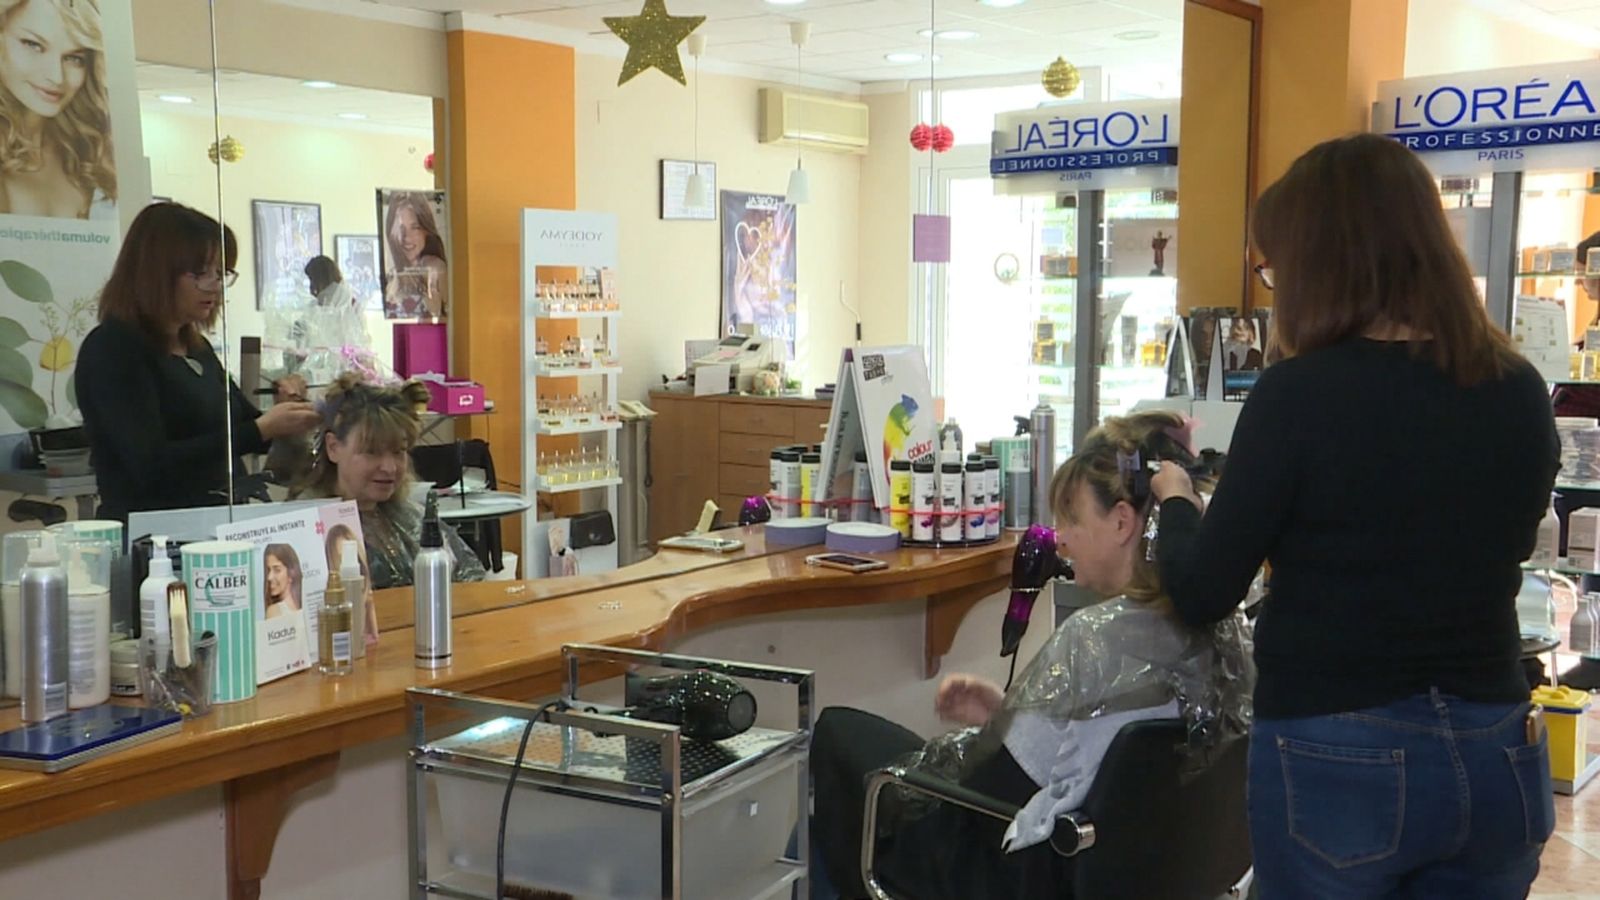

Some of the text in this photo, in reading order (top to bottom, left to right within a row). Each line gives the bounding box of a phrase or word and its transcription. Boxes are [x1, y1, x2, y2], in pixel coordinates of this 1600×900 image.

[1478, 149, 1524, 161] PARIS
[278, 520, 305, 531] INSTANTE
[195, 574, 247, 590] CALBER
[268, 626, 296, 640] Kadus
